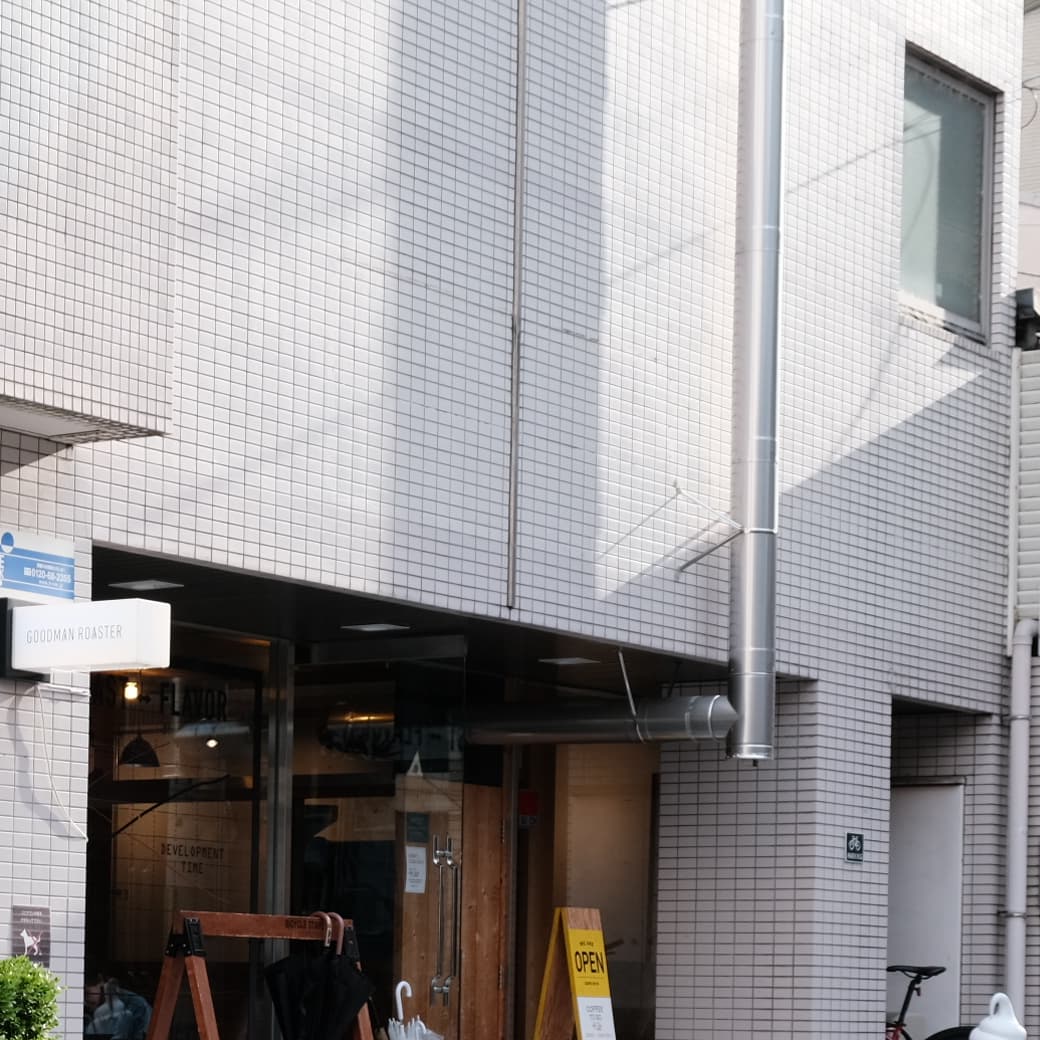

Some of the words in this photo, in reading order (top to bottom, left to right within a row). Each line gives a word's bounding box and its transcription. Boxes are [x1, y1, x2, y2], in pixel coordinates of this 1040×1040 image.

[26, 627, 75, 644] GOODMAN
[77, 624, 123, 641] ROASTER
[160, 681, 227, 721] FLAVOR
[161, 844, 224, 859] DEVELOPMENT
[181, 861, 204, 874] TIME
[575, 951, 605, 973] OPEN
